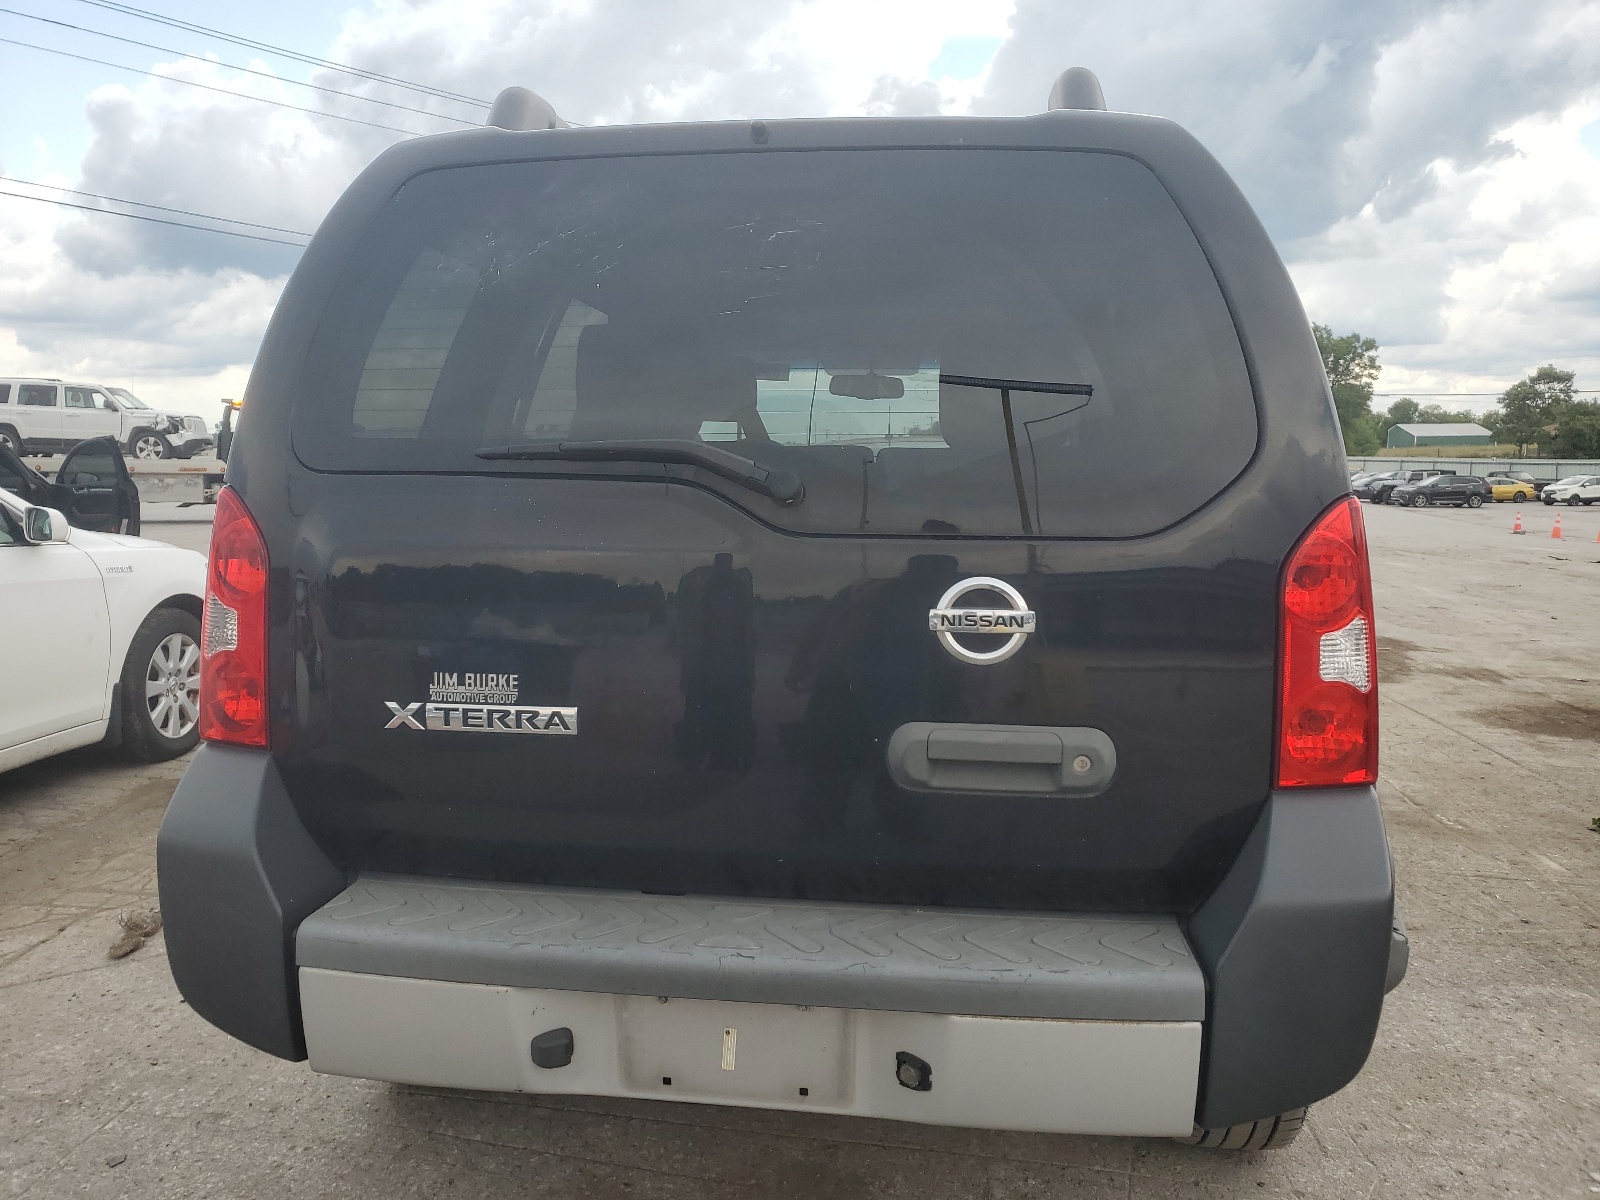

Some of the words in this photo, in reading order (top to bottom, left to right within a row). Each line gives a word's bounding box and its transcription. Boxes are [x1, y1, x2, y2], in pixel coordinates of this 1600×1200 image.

[940, 614, 1025, 628] NISSAN
[430, 672, 458, 690] JIM
[465, 673, 519, 692] BURKE
[431, 691, 486, 703] AUTOMOTIVE
[487, 693, 517, 704] GROUP
